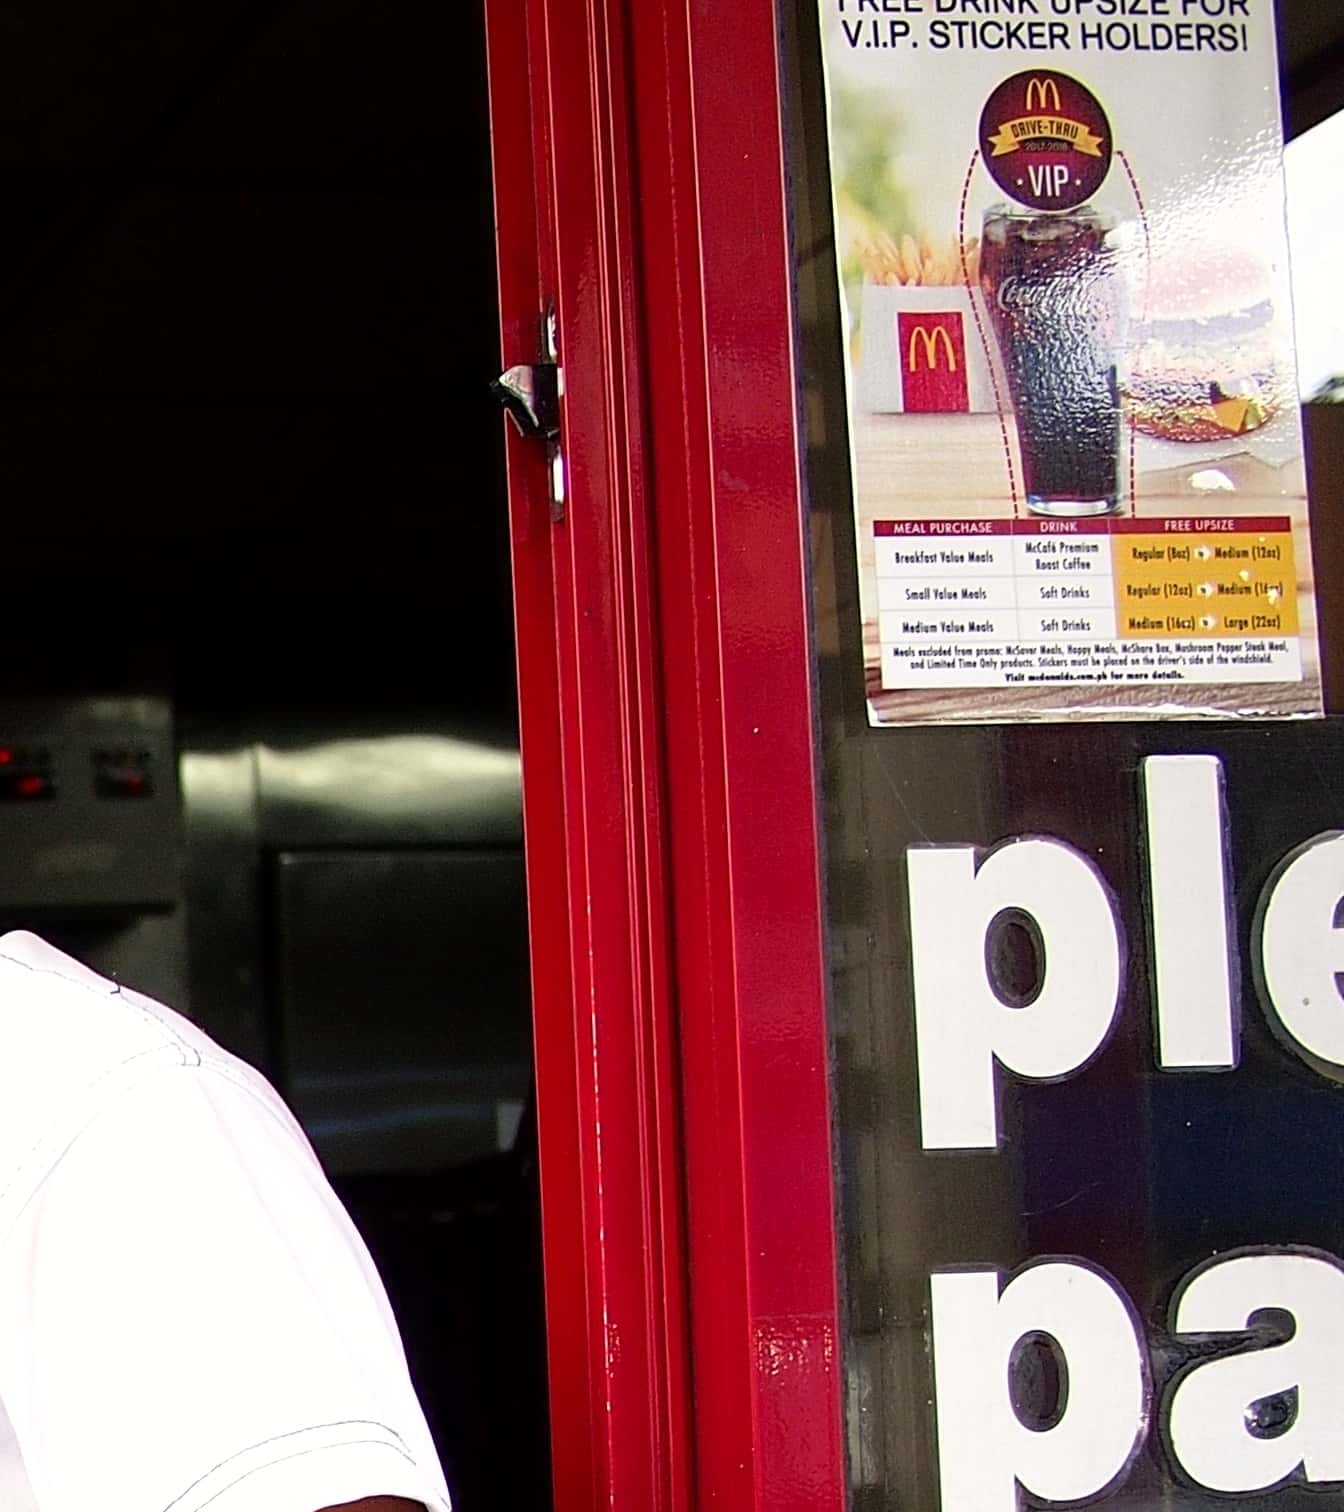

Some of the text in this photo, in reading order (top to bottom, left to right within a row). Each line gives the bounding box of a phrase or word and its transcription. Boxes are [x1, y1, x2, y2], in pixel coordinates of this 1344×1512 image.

[842, 20, 1248, 51] V.I.P. STICKER HOLDERS!
[1010, 120, 1079, 139] DRIVE-THRU
[1027, 165, 1069, 197] VIP
[894, 522, 992, 533] MEAL PURCHASE
[1040, 521, 1078, 532] DRINK
[1164, 520, 1235, 531] FREE UPSIZE
[1025, 541, 1099, 553] McCafé Premium
[1214, 546, 1281, 561] Medium (12oz)
[895, 550, 994, 564] Breakfast Value Meals
[1132, 547, 1165, 562] Regular
[1035, 558, 1091, 570] Roast Coffee
[905, 588, 987, 600] Small Value Meals
[1040, 586, 1090, 599] Soft Drinks
[1126, 583, 1193, 599] Regular (12oz)
[1217, 582, 1251, 596] Medium
[902, 620, 994, 633] Medium Value Meals
[1041, 619, 1091, 632] Soft Drinks
[1128, 616, 1163, 629] Medium
[1224, 614, 1281, 630] Large (22oz)
[910, 658, 925, 669] and
[928, 658, 955, 669] Limited
[959, 657, 977, 668] Time
[980, 657, 997, 670] Only
[1038, 656, 1068, 667] Stickers
[1070, 656, 1088, 667] must
[1092, 654, 1100, 665] be
[1143, 654, 1155, 665] the
[1189, 653, 1204, 664] side
[1217, 652, 1229, 663] the
